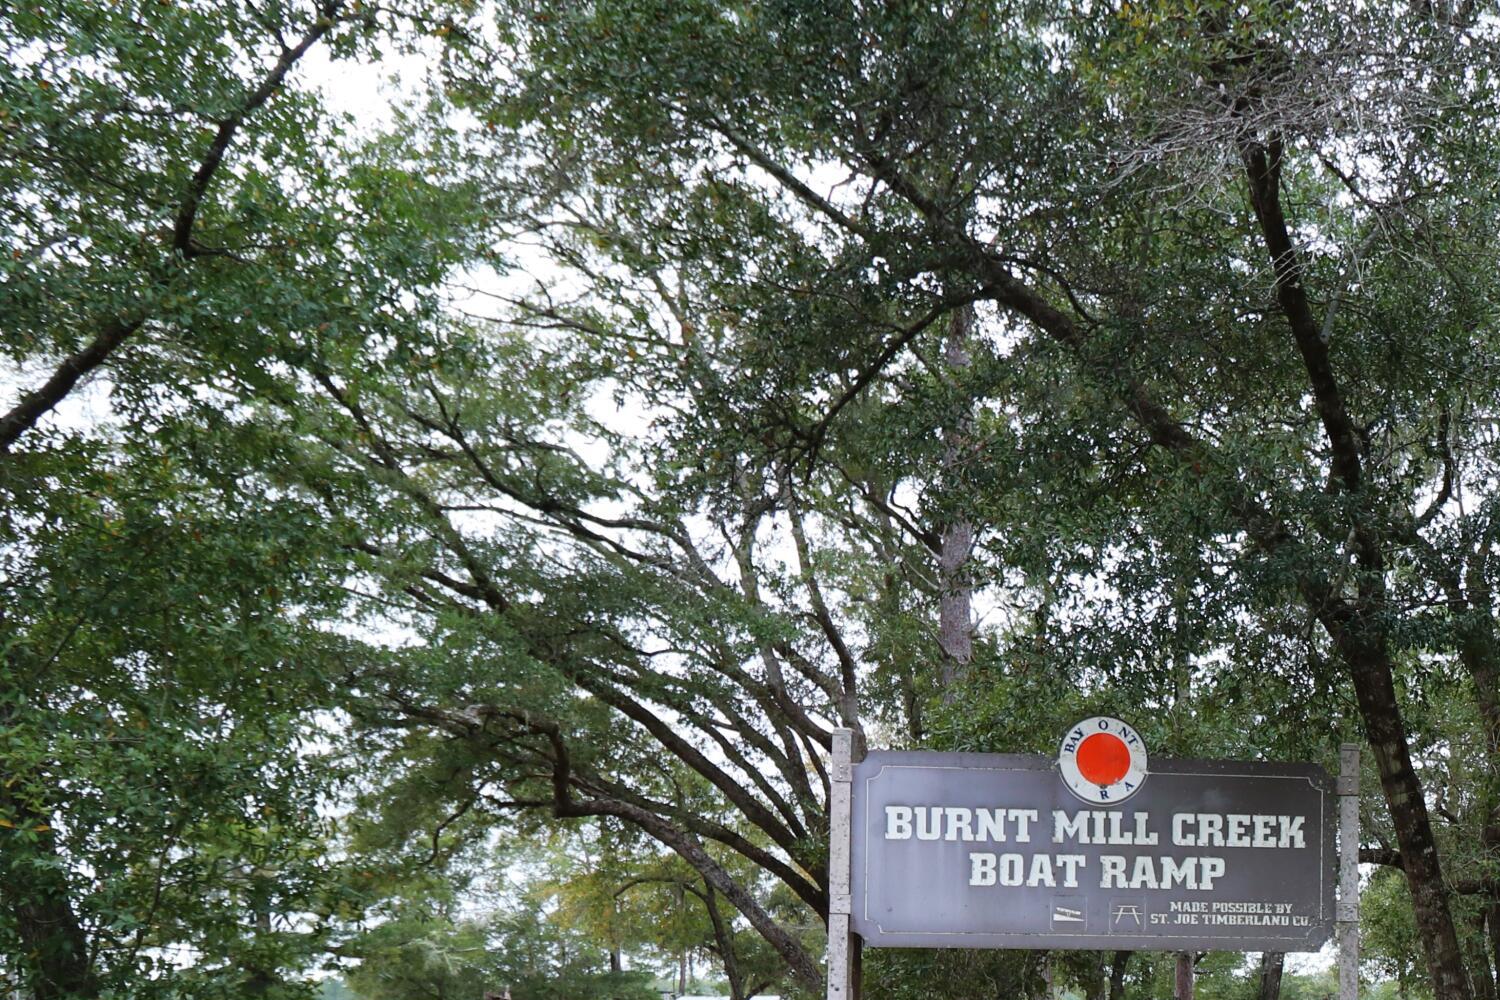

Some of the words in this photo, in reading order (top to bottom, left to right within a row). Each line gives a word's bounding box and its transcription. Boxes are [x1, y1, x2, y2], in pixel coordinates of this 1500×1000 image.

[1064, 727, 1084, 754] BAY
[885, 806, 1038, 842] BURNT
[1052, 809, 1159, 845] MILL
[1172, 813, 1306, 848] CREEK
[969, 852, 1086, 888] BOAT
[1100, 855, 1226, 890] RAMP
[1150, 913, 1170, 925] ST.
[1173, 913, 1199, 925] JOE
[1202, 914, 1289, 926] TIMBERLAND
[1169, 901, 1209, 913] MADE
[1212, 902, 1272, 914] POSSIBLE
[1275, 903, 1293, 914] BY
